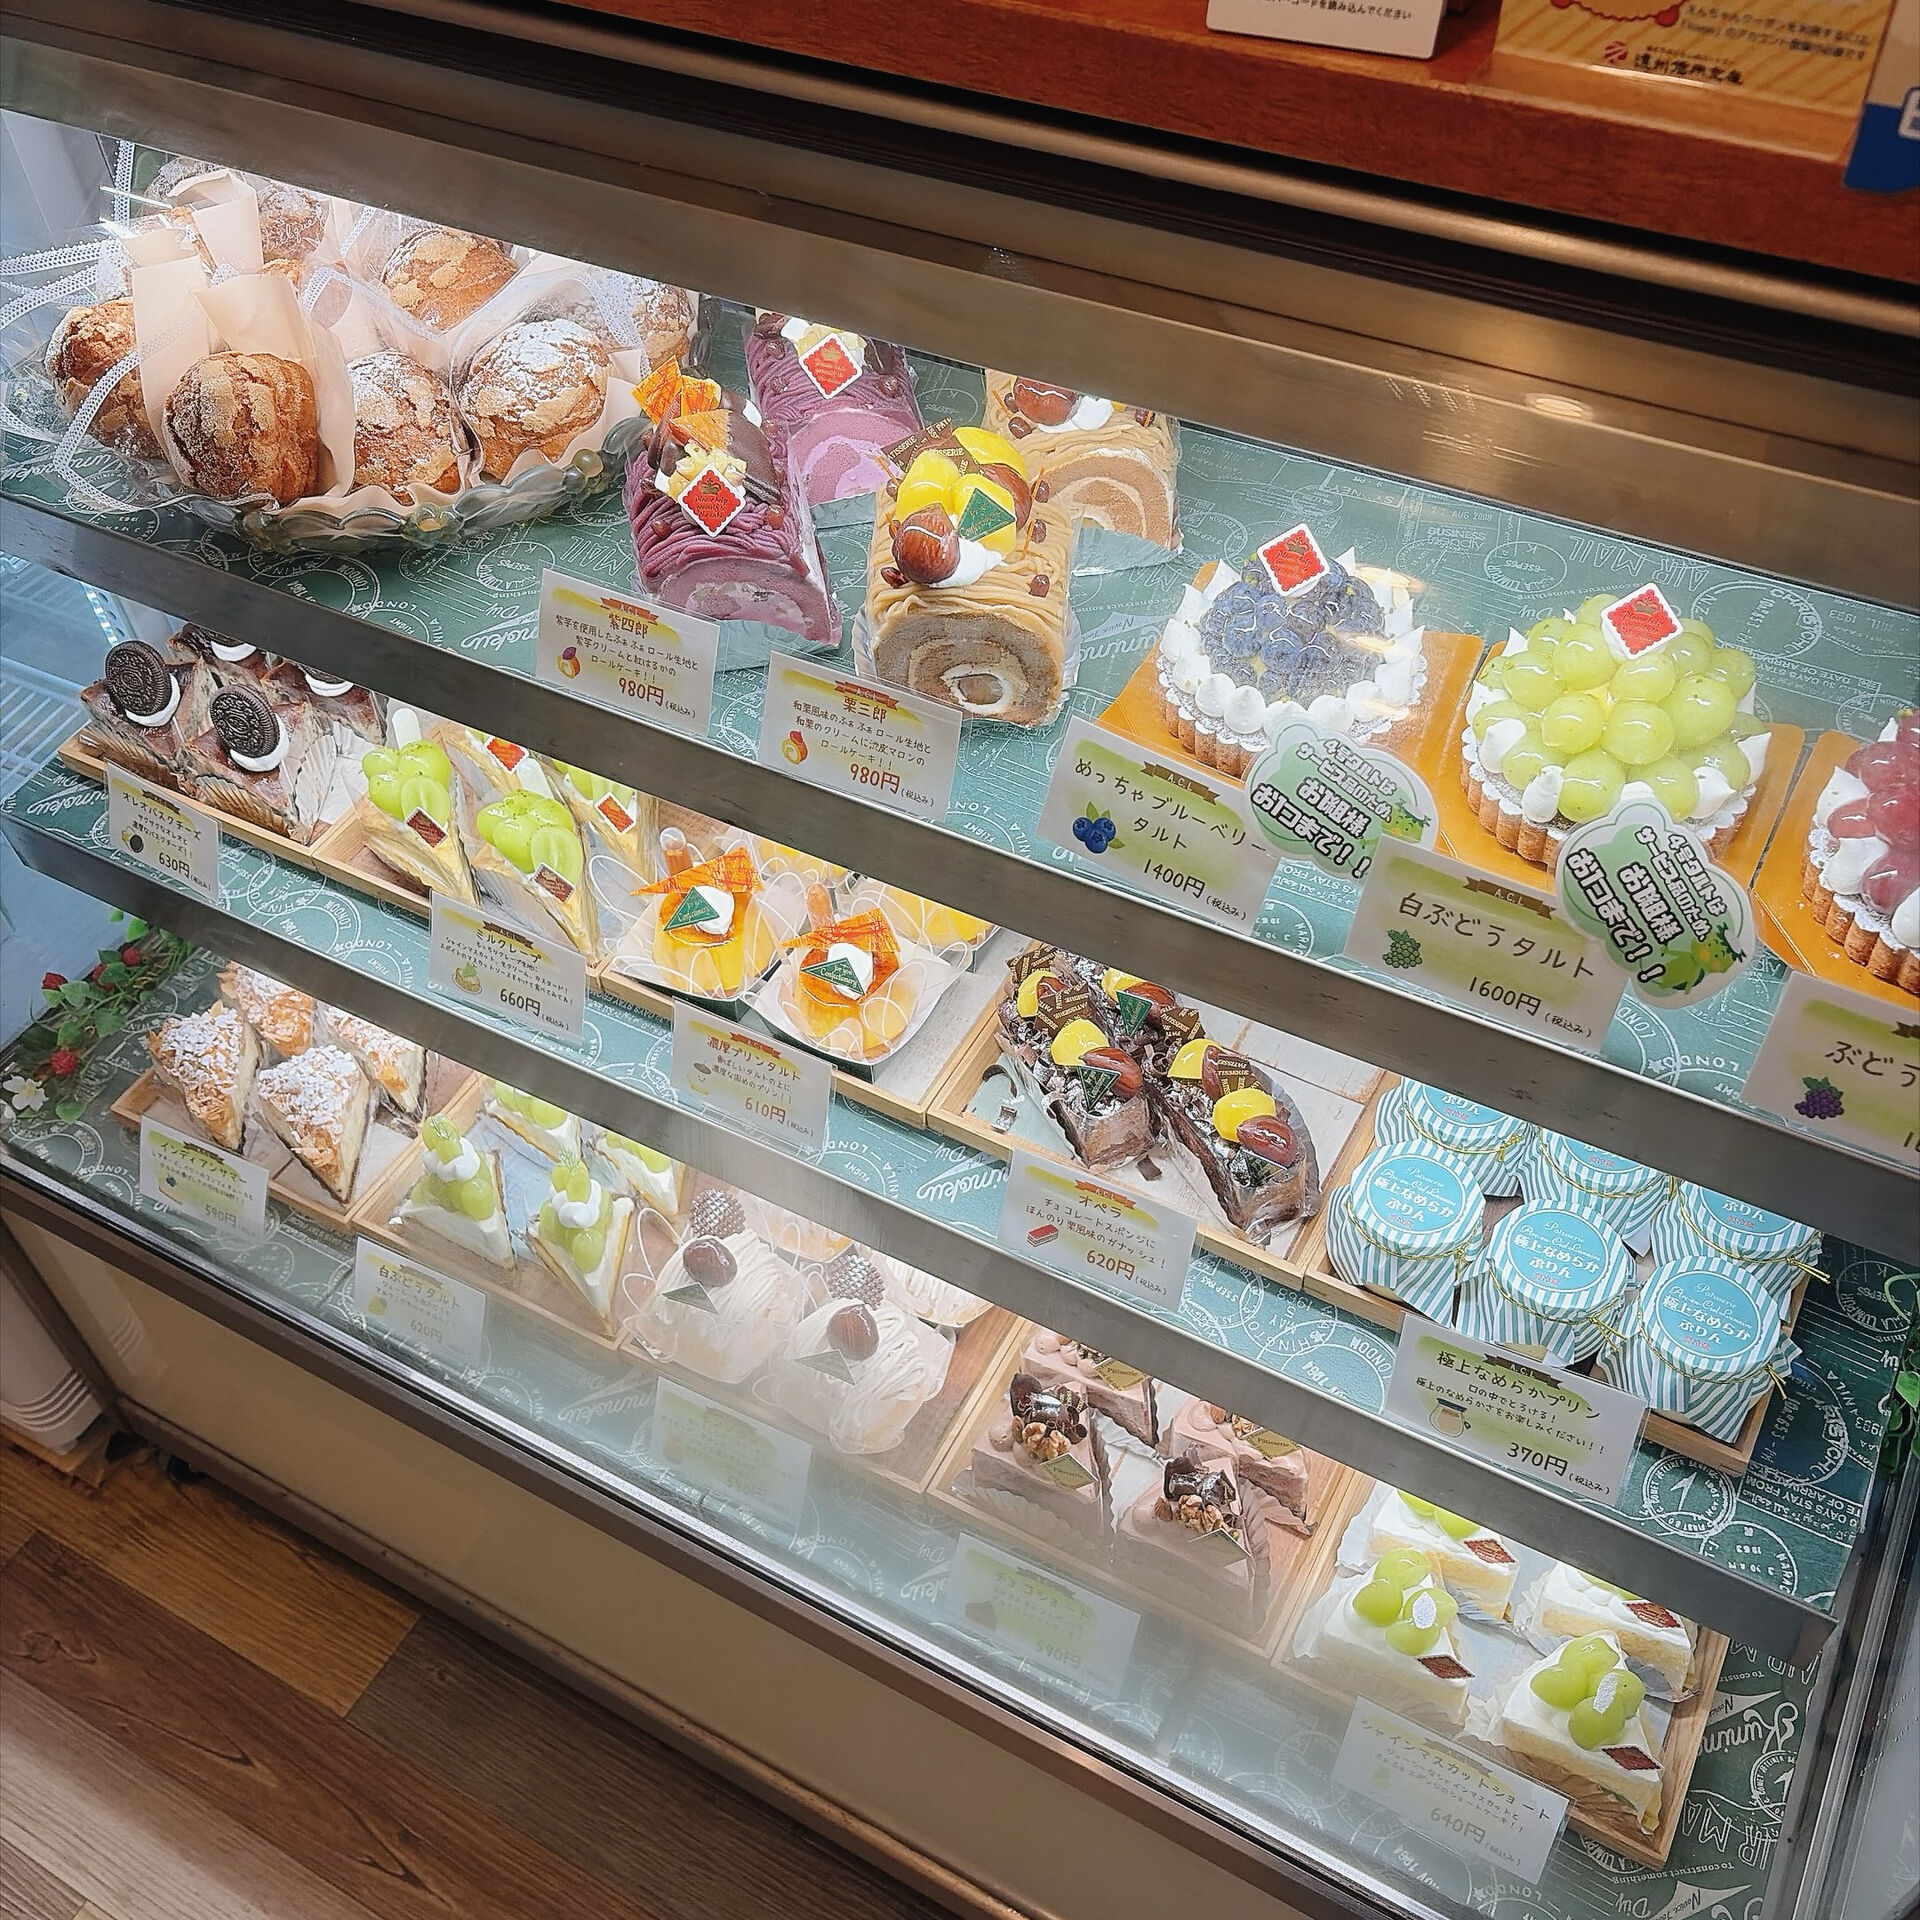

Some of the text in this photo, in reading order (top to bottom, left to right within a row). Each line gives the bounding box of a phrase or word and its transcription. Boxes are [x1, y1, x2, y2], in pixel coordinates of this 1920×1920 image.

[559, 535, 619, 576] MAIL
[1569, 535, 1645, 576] MAIL
[1652, 558, 1709, 592] AIR
[485, 604, 520, 619] Diy
[609, 613, 648, 639] 紫四郎
[1518, 605, 1552, 620] Diy
[576, 636, 676, 676] 紫芋クリームと紅はるかの
[592, 656, 656, 683] ロールケーキ！！
[619, 678, 664, 706] 980円
[843, 696, 887, 724] 栗三郎
[796, 716, 924, 766] 和栗のクリームに渋皮マロンの
[821, 740, 893, 769] ロールケーキ！！
[52, 773, 78, 786] Diy
[851, 764, 900, 794] 980円
[1296, 742, 1392, 823] サービス品のため、
[1323, 738, 1398, 797] 4号タルトは
[123, 792, 201, 841] オレオバスクチーズ
[1075, 758, 1267, 854] めっちゃブルーベリー
[1134, 817, 1187, 850] タルト
[159, 852, 190, 878] 630円
[1667, 833, 1728, 918] 4号タルトは
[1144, 858, 1247, 921] 1400円 (税込み)
[1309, 875, 1340, 891] STAY
[1635, 826, 1713, 943] サービス品のため、
[476, 929, 541, 963] ミルクレープ
[1399, 892, 1594, 980] 白ぶどうタルト
[500, 989, 541, 1017] 660円
[1469, 976, 1592, 1039] 1600円 (税込み)
[707, 1037, 800, 1081] 濃厚プリンタルト
[746, 1097, 785, 1124] 610円
[161, 1143, 247, 1183] インディアンサマー
[934, 1143, 966, 1162] Diy
[1079, 1195, 1121, 1217] オペラ
[1373, 1176, 1454, 1219] 極上なめらか
[1386, 1199, 1425, 1222] ぷりん
[1722, 1200, 1765, 1223] ぷりん
[205, 1204, 236, 1228] 590円
[1044, 1198, 1155, 1248] チョコレートスポンジに
[1087, 1250, 1135, 1280] 620円
[1513, 1234, 1600, 1274] 極上なめらか
[1529, 1256, 1572, 1279] ぷりん
[380, 1266, 460, 1309] 白ぶどうタルト
[1284, 1306, 1295, 1318] 5
[1662, 1296, 1750, 1341] 極上なめらか
[1678, 1319, 1722, 1345] ぷりん
[1437, 1350, 1600, 1419] 極上なめらかプリン
[1469, 1384, 1556, 1423] 口の中でとろける！
[1507, 1442, 1610, 1495] 370円 (税込み)
[1745, 1475, 1846, 1523] DAYS STAY FROM
[1827, 1498, 1844, 1509] OF
[1361, 1719, 1550, 1821] シャインマスカットショート
[1430, 1807, 1486, 1843] 640円
[1612, 1861, 1734, 1884] To construct something
[1614, 1893, 1650, 1918] Diy
